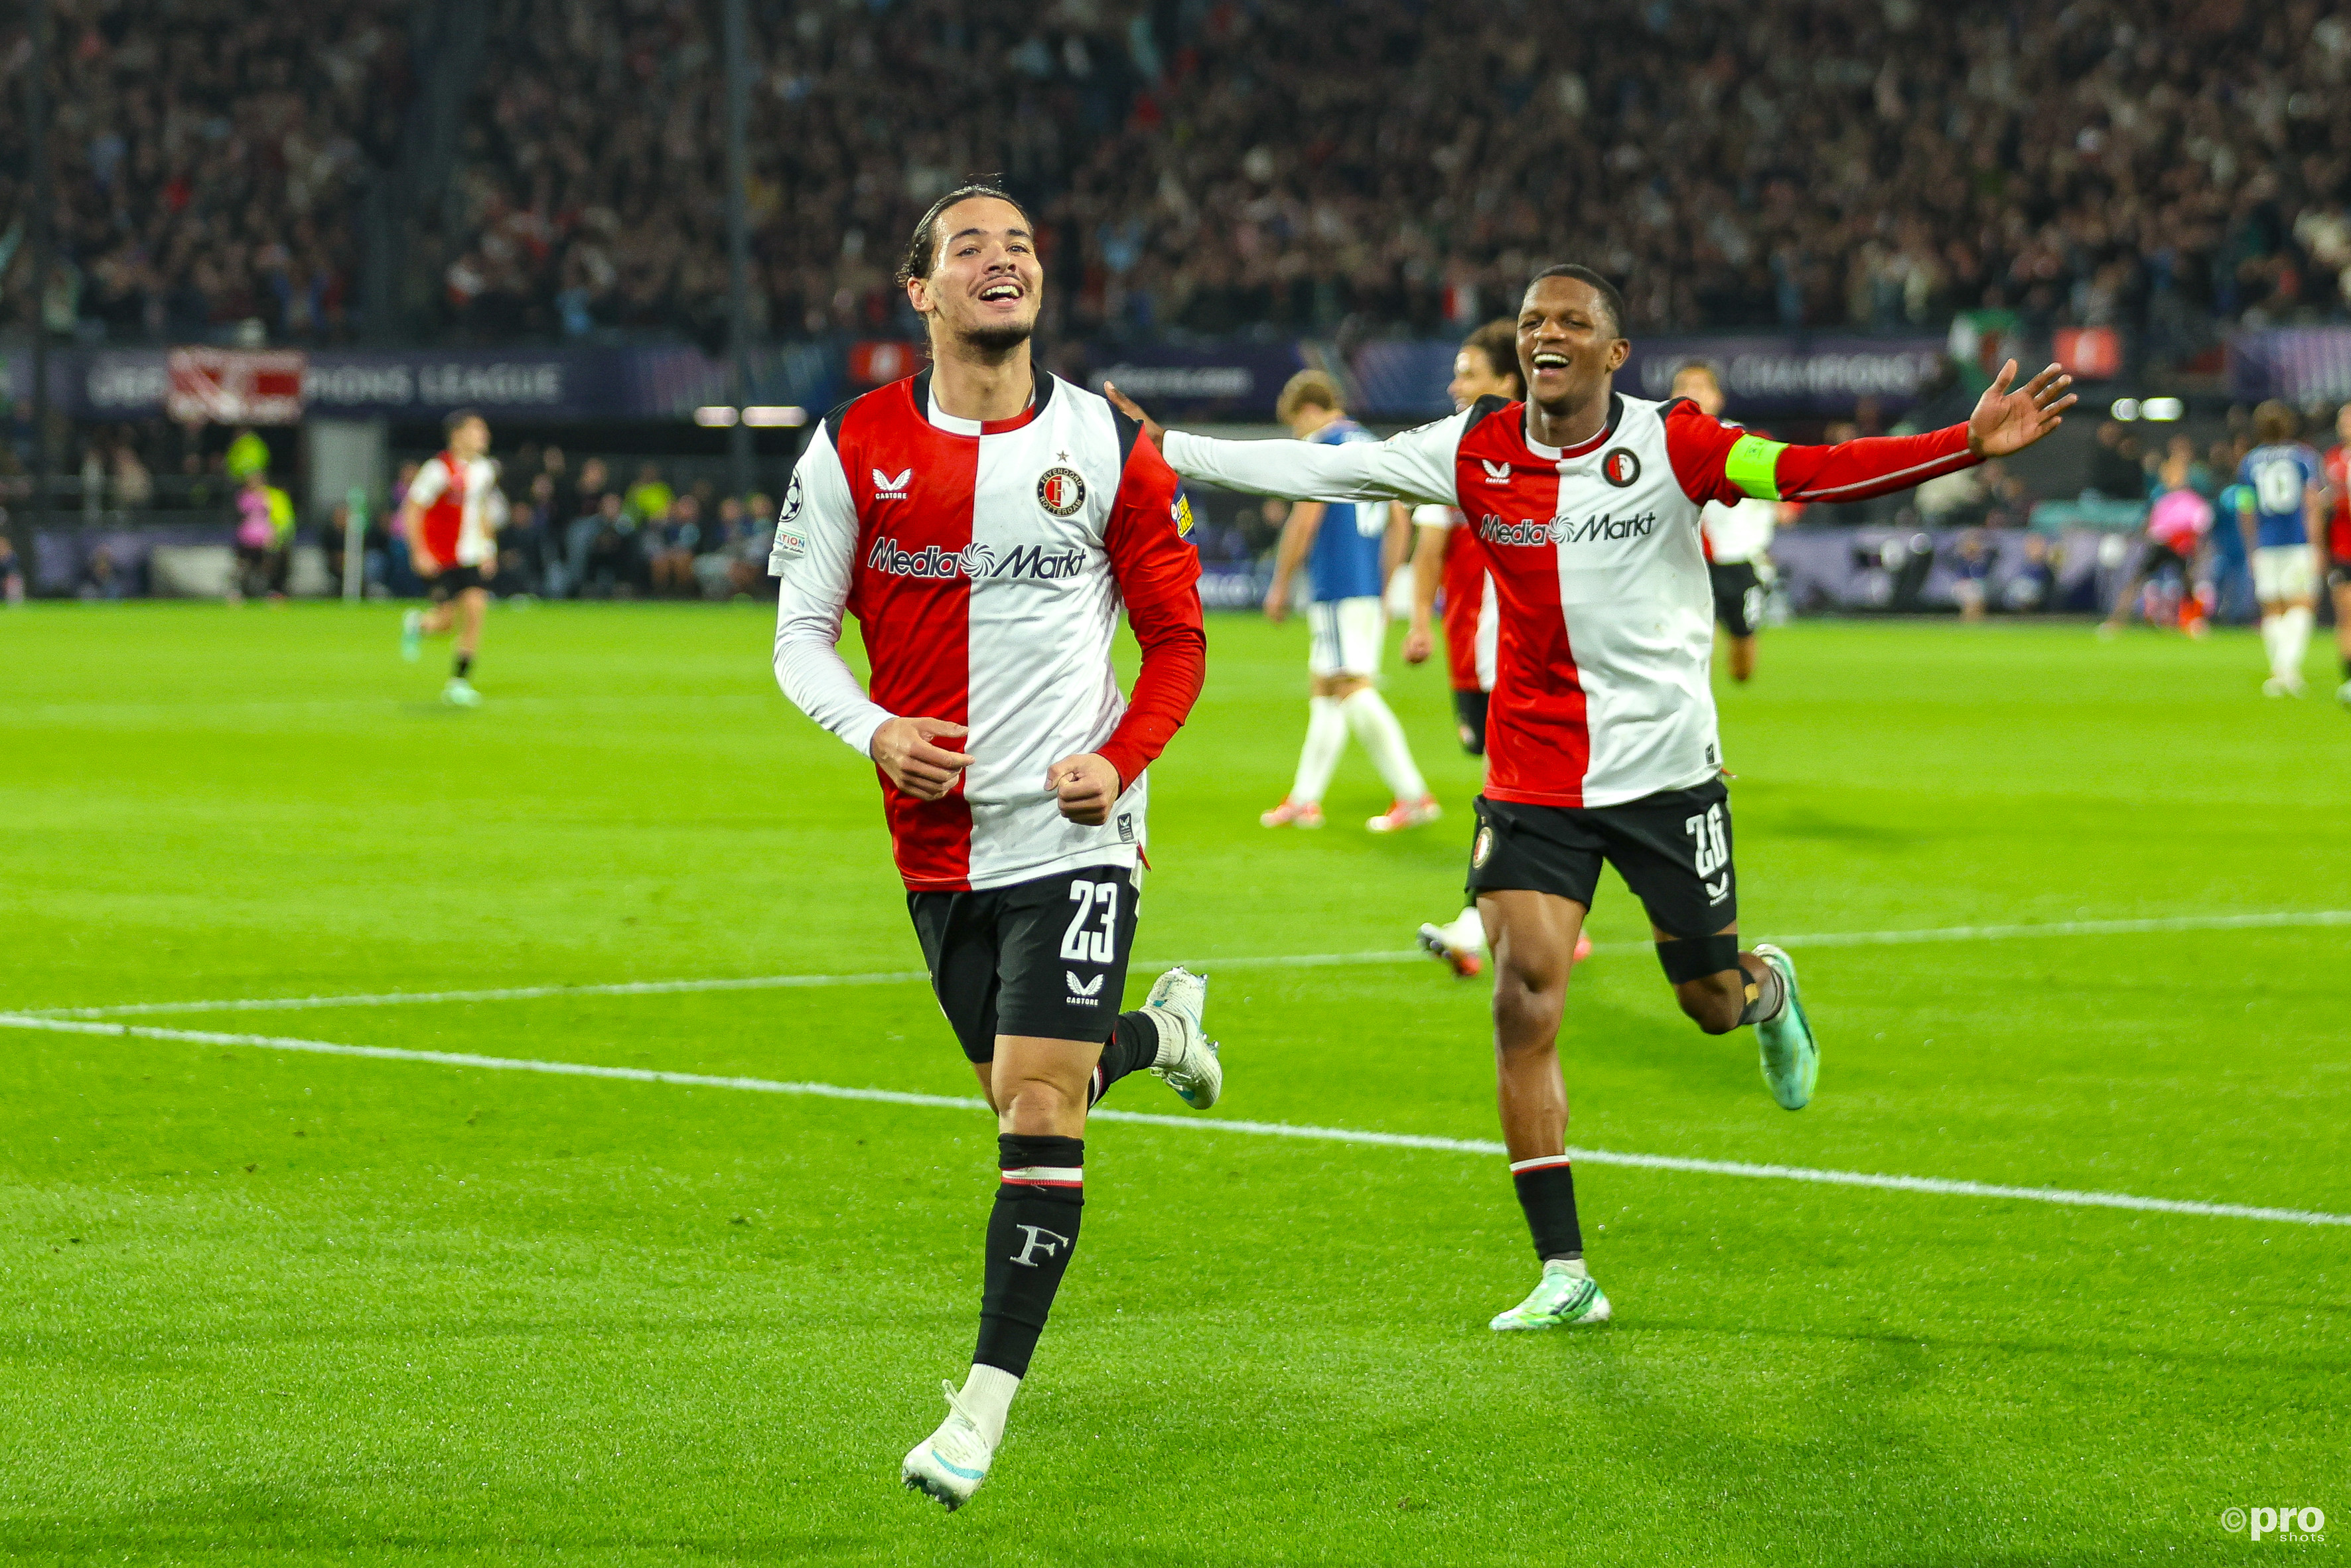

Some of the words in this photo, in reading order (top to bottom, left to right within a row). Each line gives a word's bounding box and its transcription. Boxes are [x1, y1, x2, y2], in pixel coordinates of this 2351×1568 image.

[1040, 468, 1082, 486] FEYENOORD
[2250, 459, 2303, 516] 10
[1039, 496, 1082, 515] ROTTERDAM
[1480, 513, 1547, 547] Media
[1571, 512, 1656, 543] Markt
[868, 536, 960, 578] Media
[989, 544, 1086, 579] Markt
[1685, 802, 1729, 881] 26
[1060, 879, 1117, 963] 23
[1066, 997, 1099, 1007] CASTORE
[1009, 1223, 1070, 1267] F
